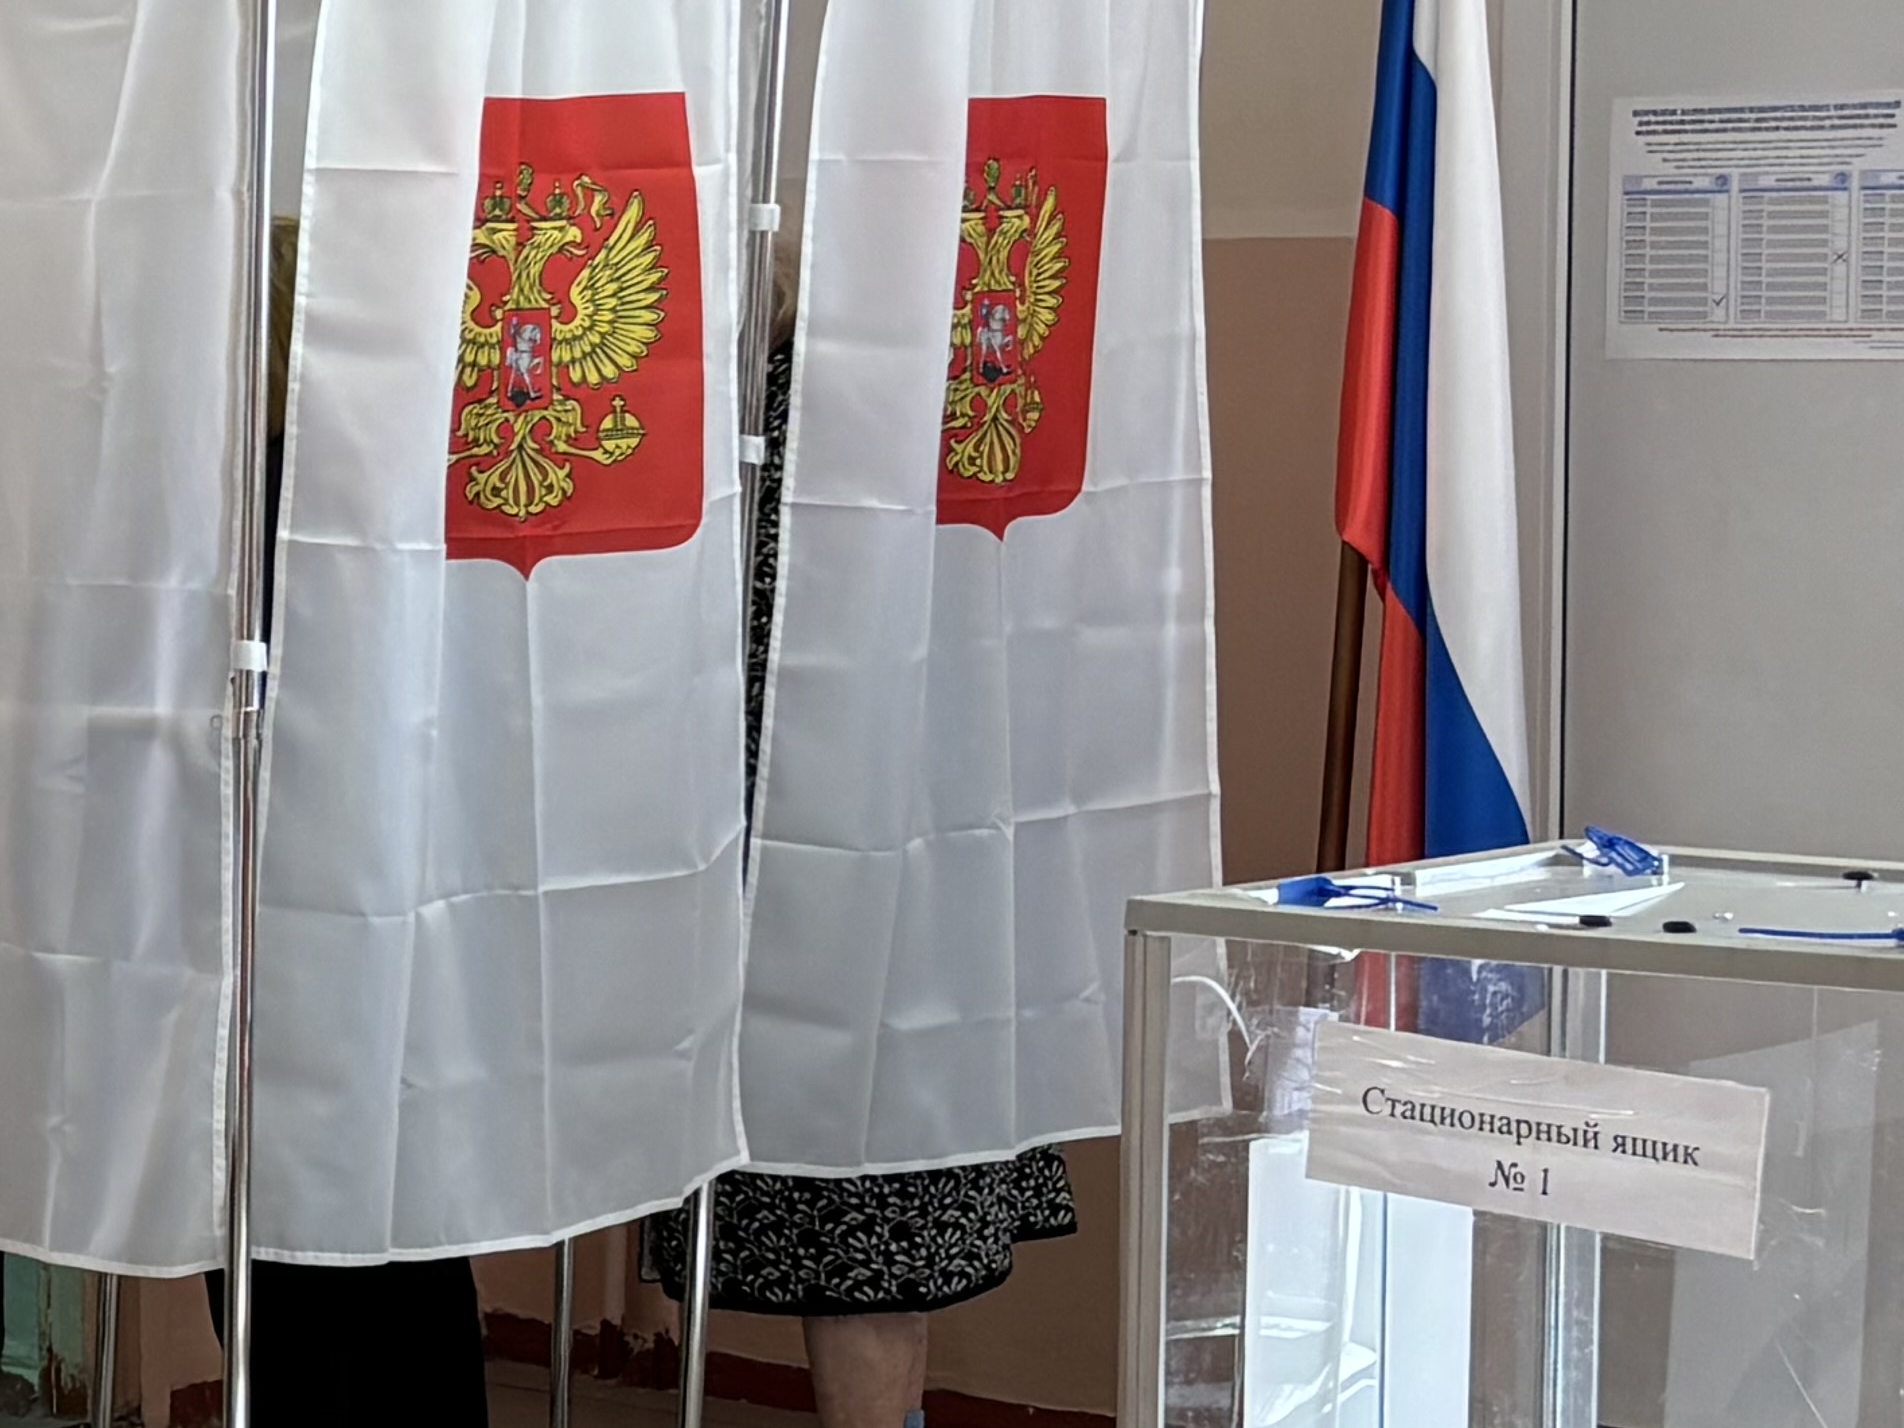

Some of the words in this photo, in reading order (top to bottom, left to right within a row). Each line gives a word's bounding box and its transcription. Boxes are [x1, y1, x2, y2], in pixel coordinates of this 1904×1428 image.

[1362, 1086, 1600, 1150] Стационарный
[1611, 1133, 1701, 1167] ящик
[1488, 1159, 1526, 1192] №
[1539, 1167, 1550, 1196] 1
